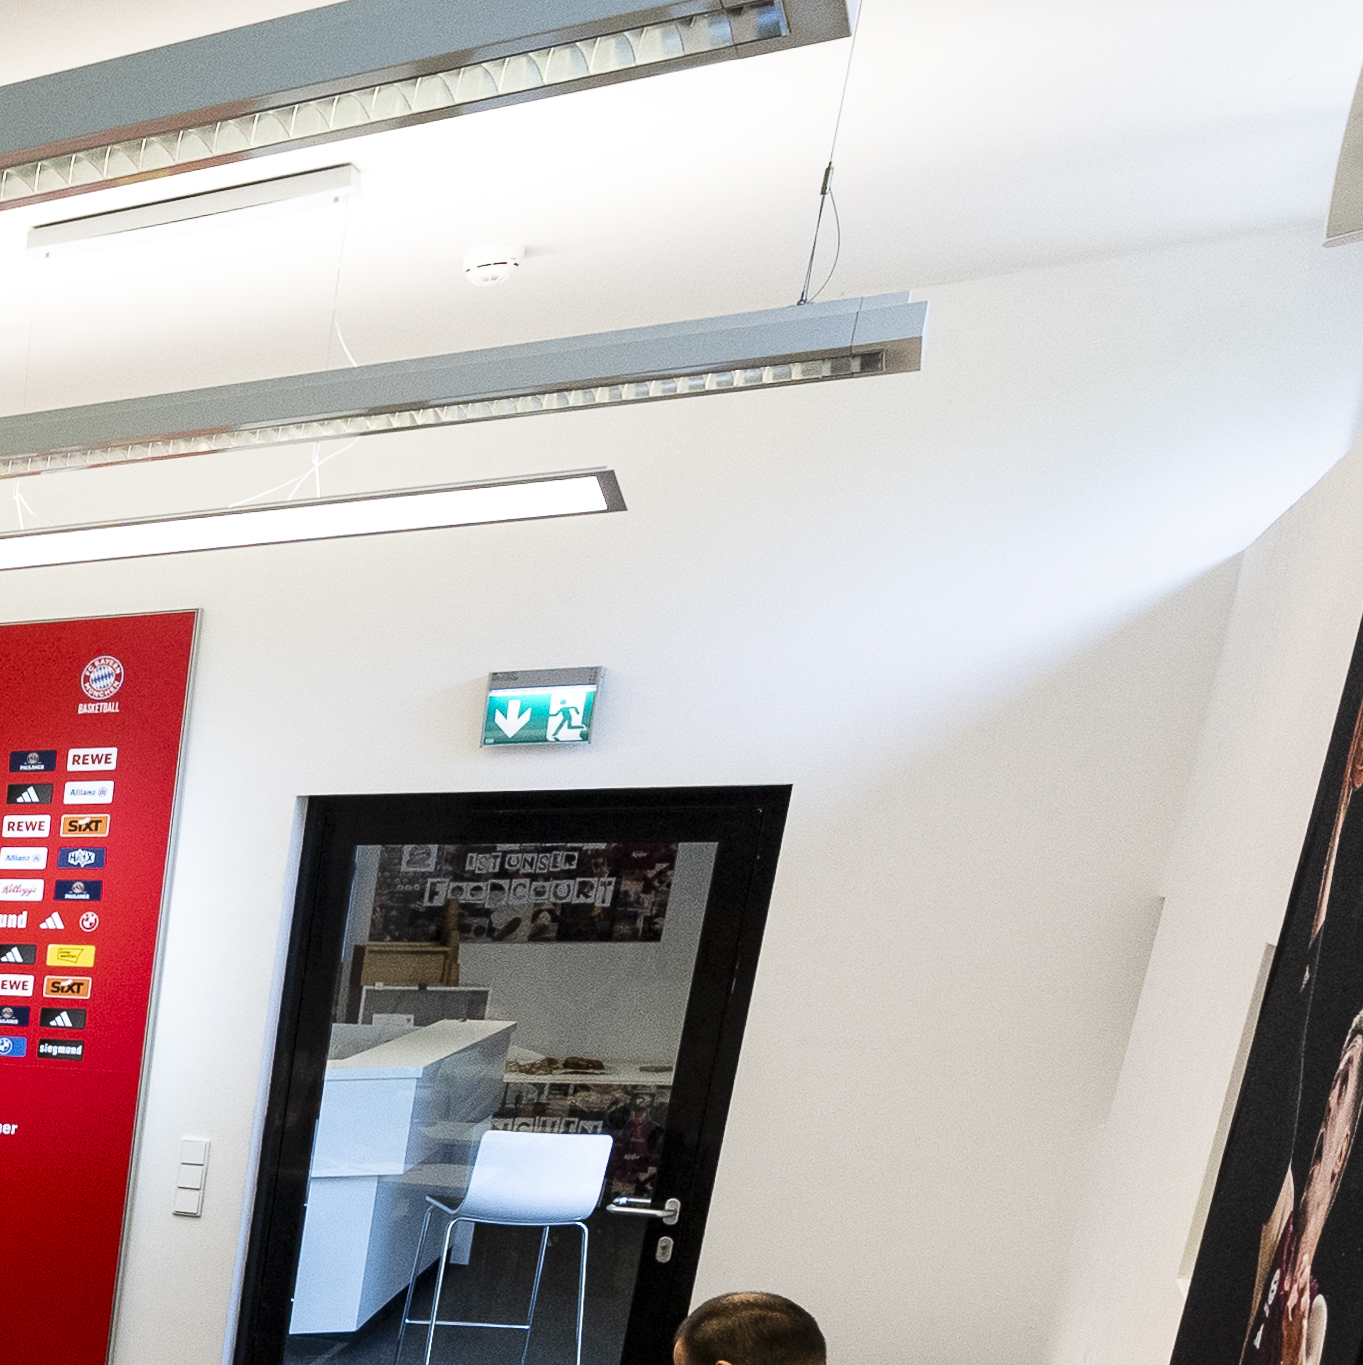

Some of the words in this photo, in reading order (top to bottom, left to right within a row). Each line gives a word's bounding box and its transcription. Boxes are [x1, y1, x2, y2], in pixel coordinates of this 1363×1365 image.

[78, 702, 120, 715] BASKETBALL
[72, 753, 112, 765] REWE
[7, 821, 45, 832] REWE
